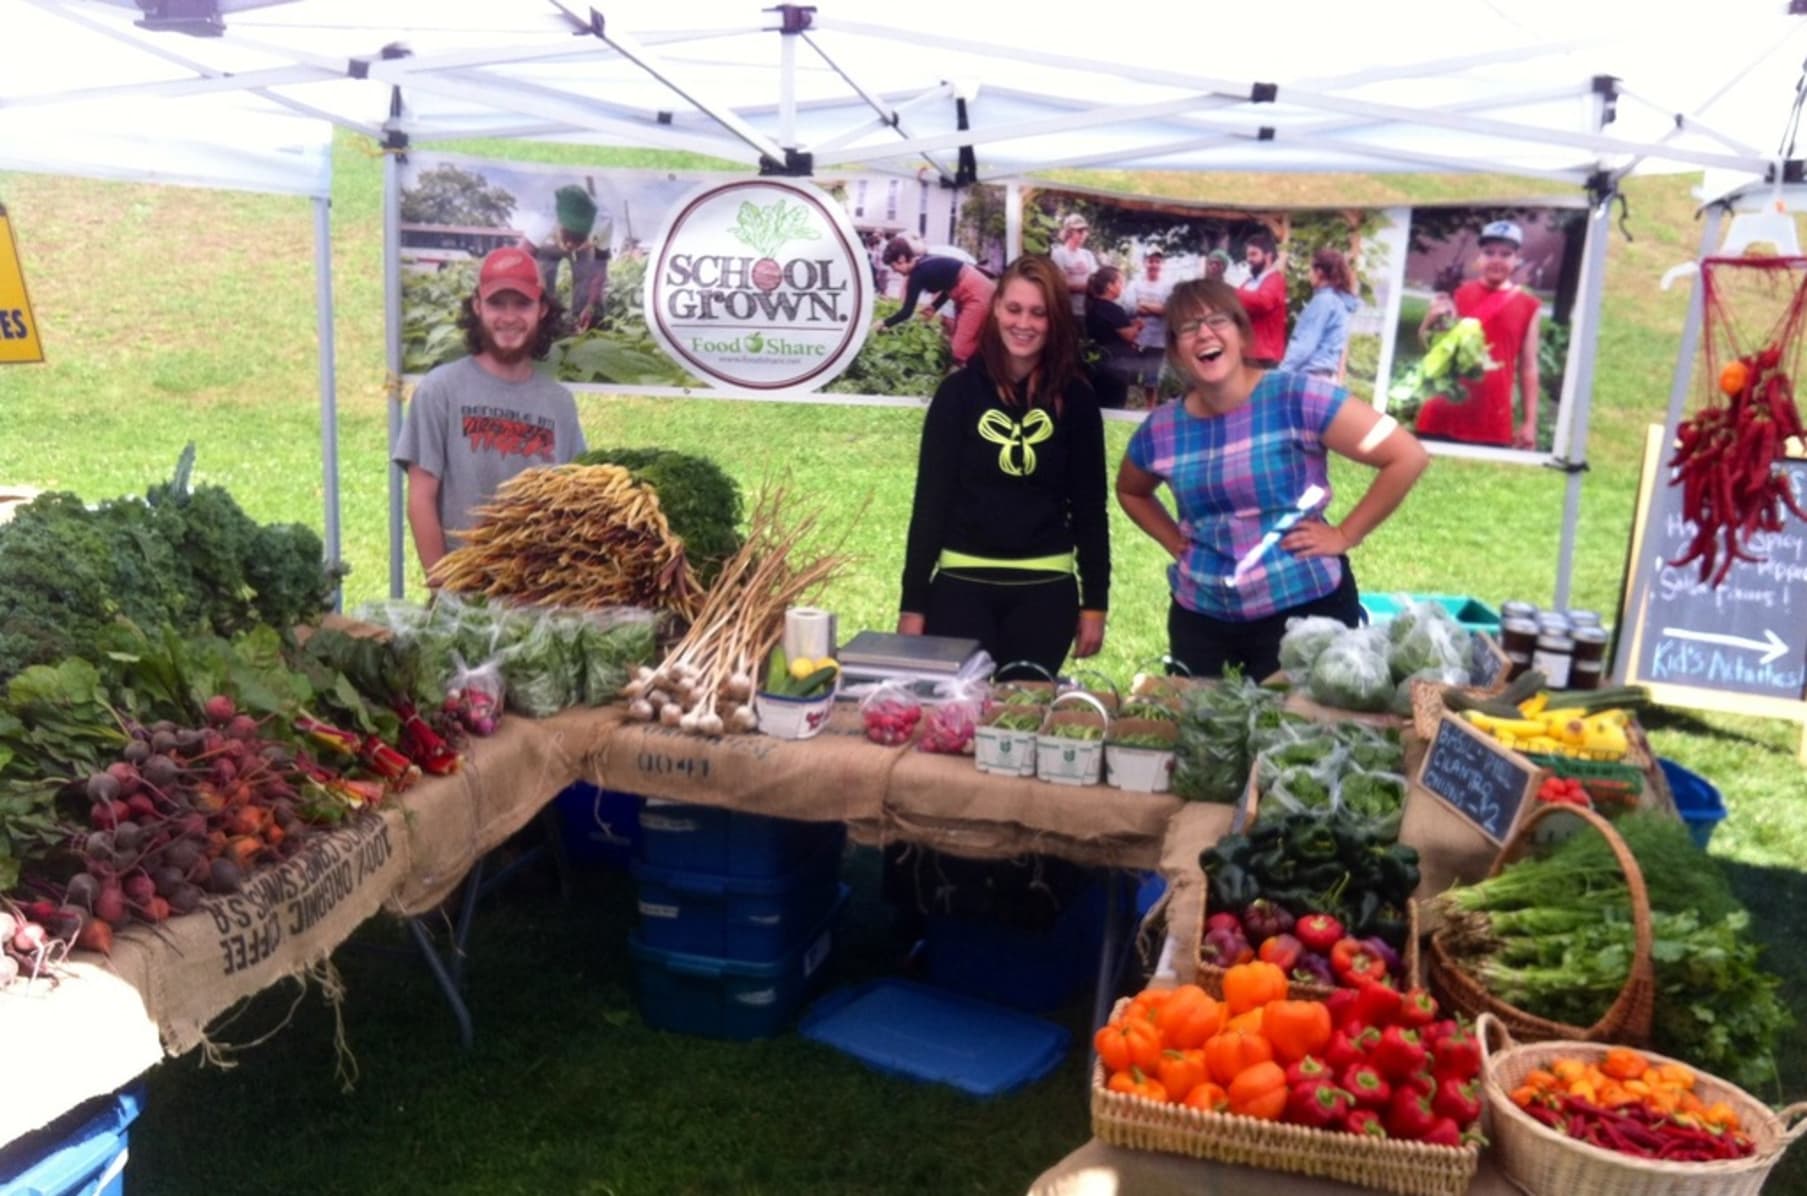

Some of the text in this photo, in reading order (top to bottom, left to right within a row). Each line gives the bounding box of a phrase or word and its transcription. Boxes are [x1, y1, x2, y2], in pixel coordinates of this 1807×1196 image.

[666, 253, 847, 292] SCHOOL
[692, 335, 826, 356] Food Share
[288, 858, 353, 936] ORGANIC
